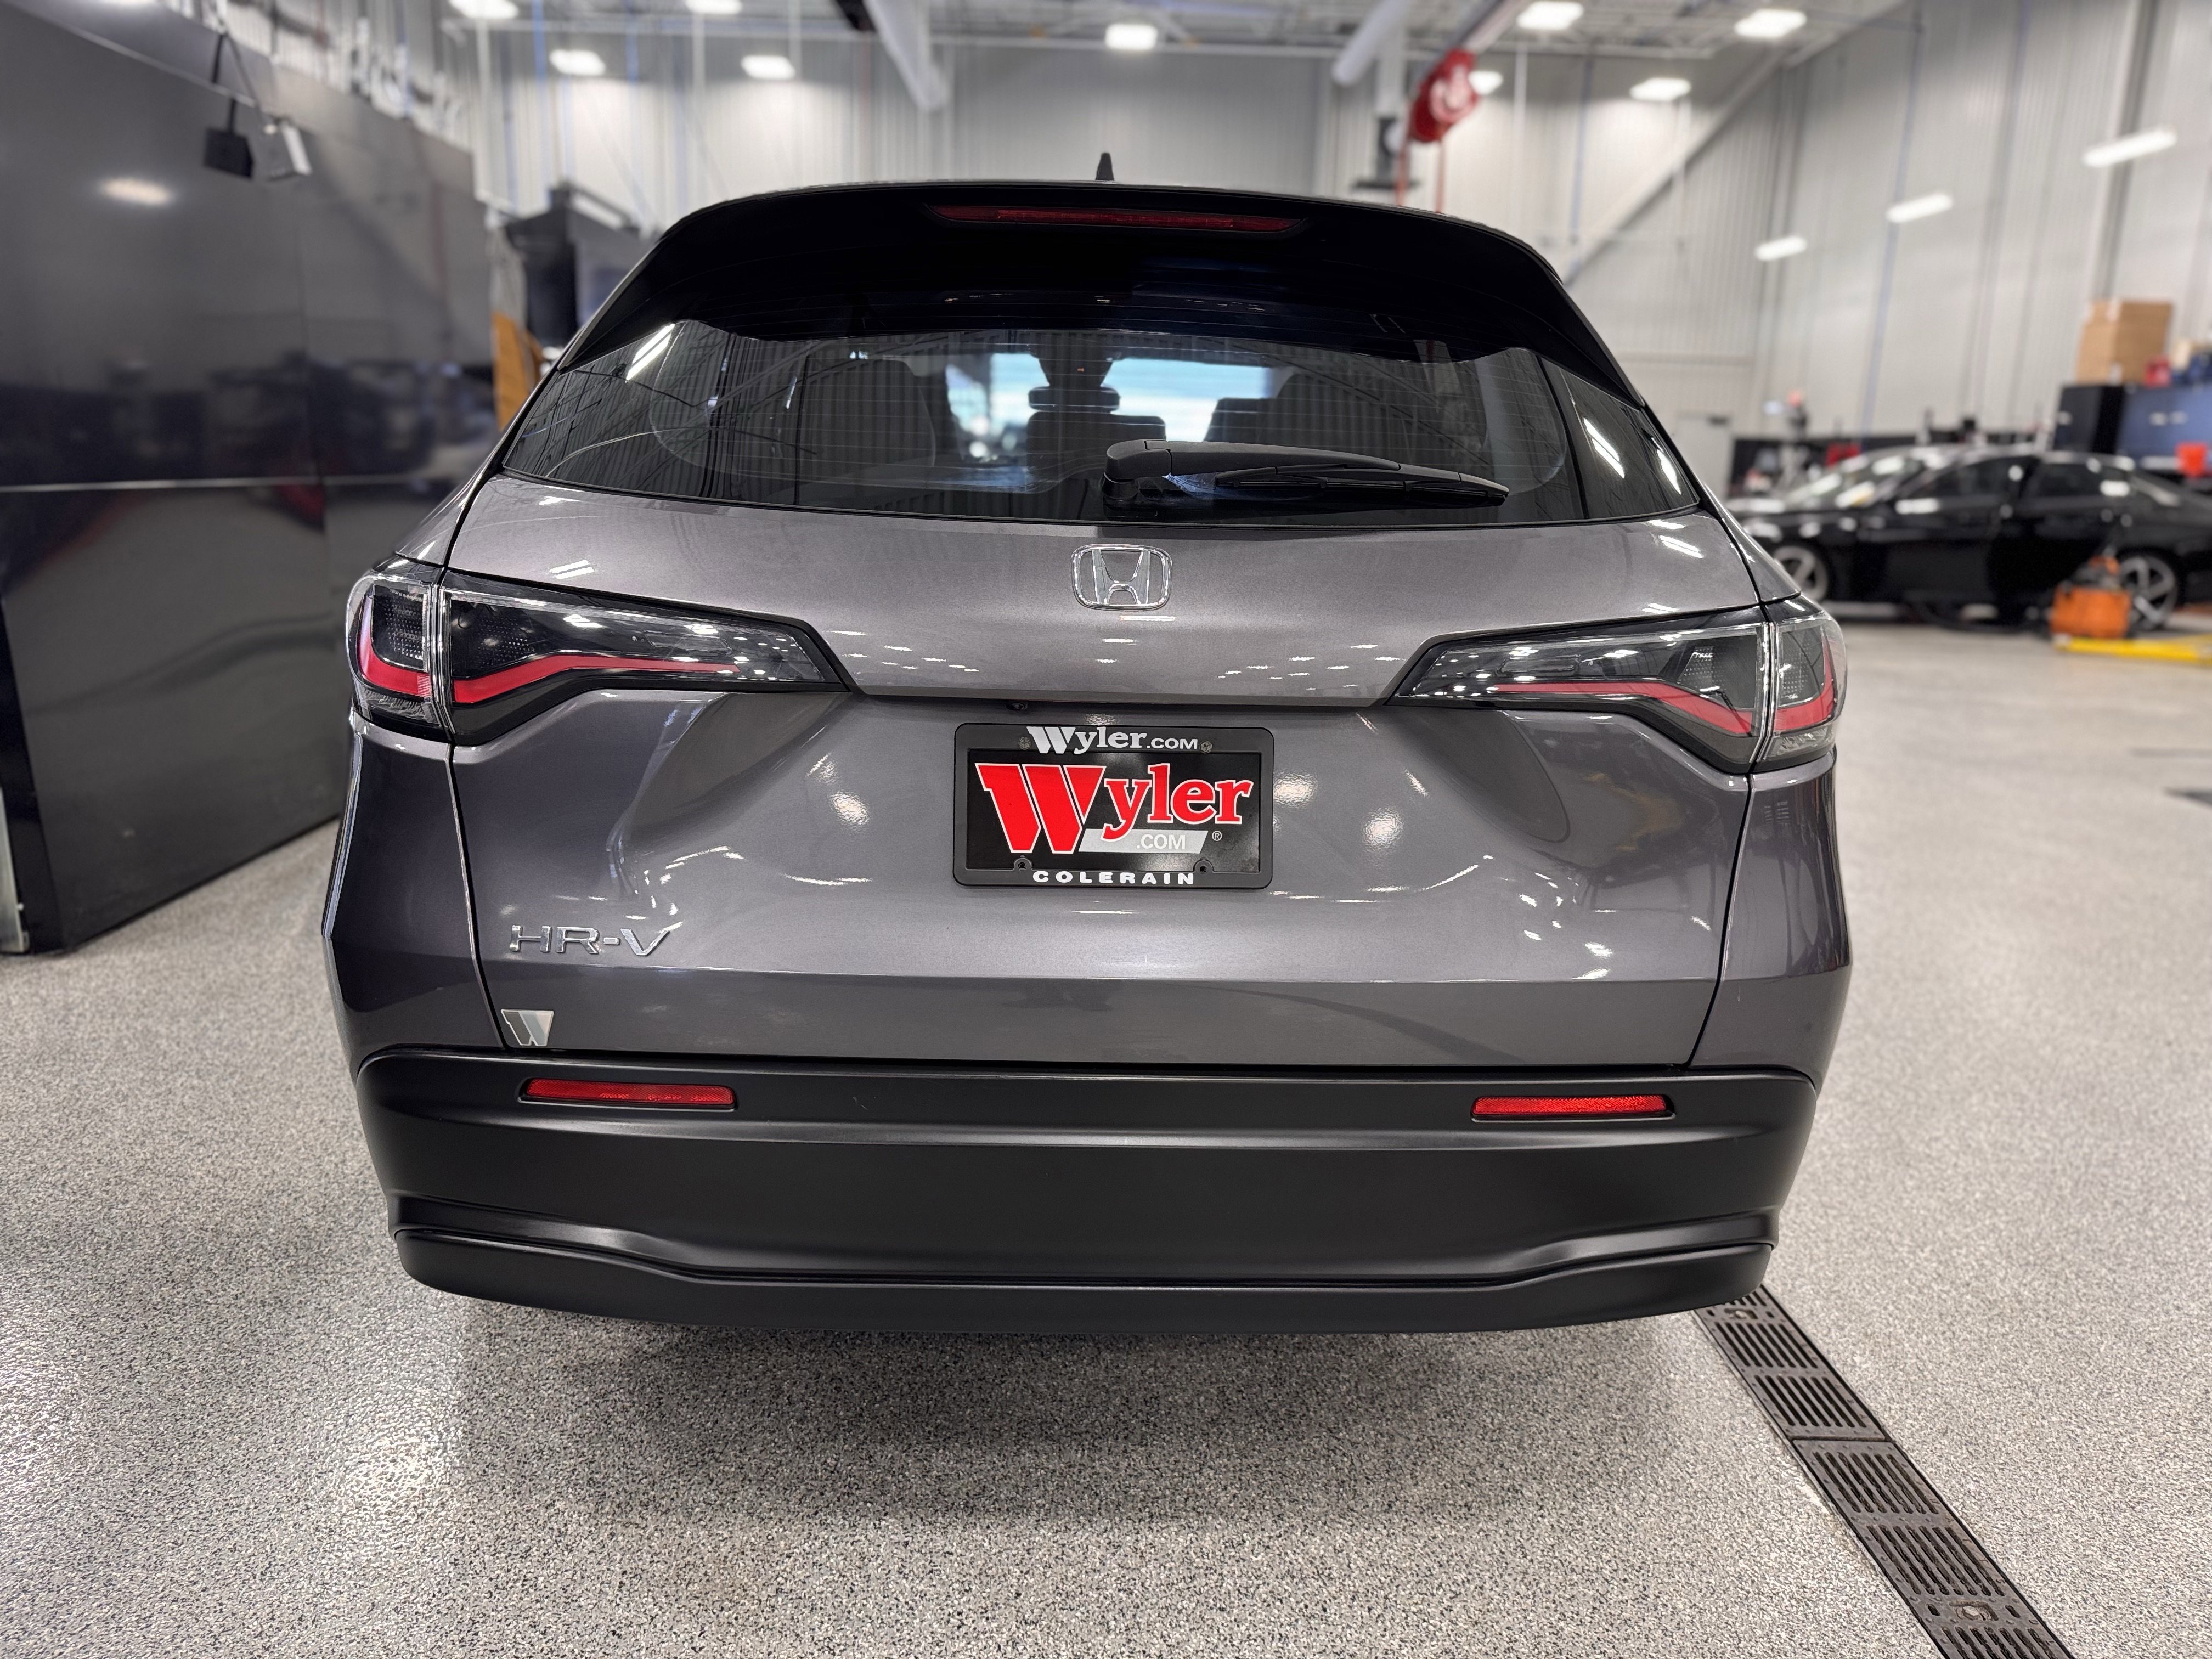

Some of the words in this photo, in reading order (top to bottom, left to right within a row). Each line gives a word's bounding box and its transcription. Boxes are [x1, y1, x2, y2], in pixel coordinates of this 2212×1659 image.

[974, 763, 1254, 854] Wyler
[1136, 834, 1186, 850] .COM
[1032, 871, 1194, 885] COLERAIN
[509, 924, 672, 956] HR-V
